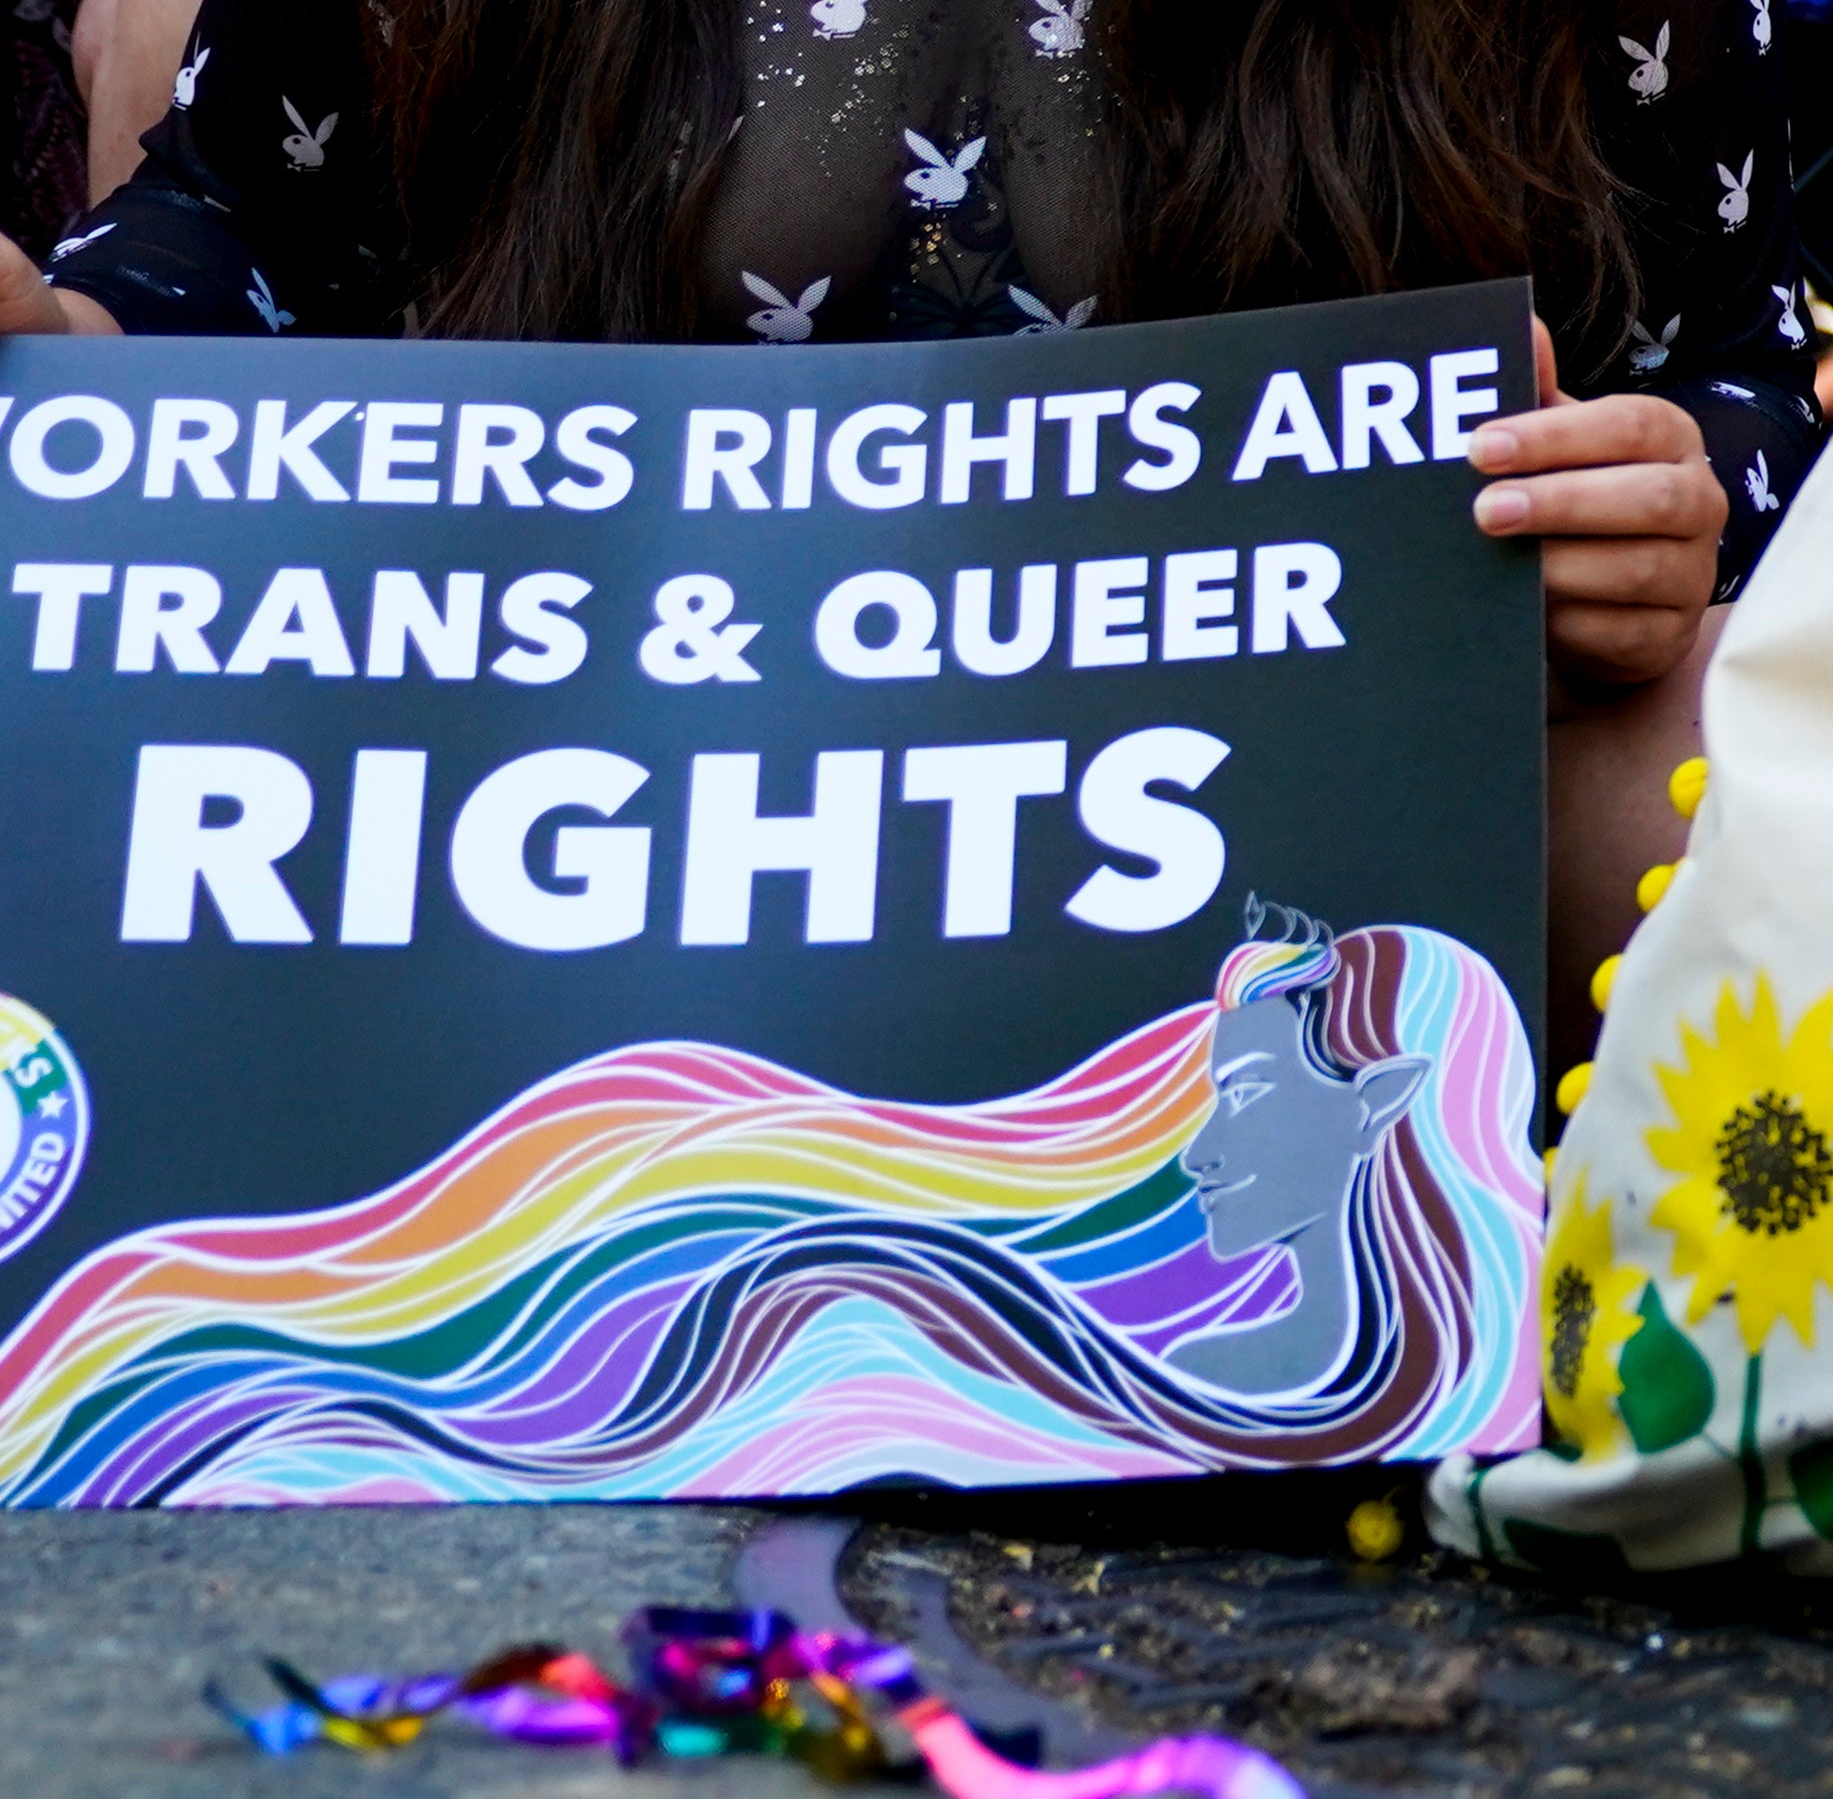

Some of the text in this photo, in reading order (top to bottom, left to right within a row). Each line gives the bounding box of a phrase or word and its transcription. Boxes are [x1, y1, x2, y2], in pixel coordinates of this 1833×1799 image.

[0, 347, 1500, 511] ORKERS RIGHTS ARE
[12, 542, 1347, 685] TRANS & QUEER
[120, 726, 1232, 953] RIGHTS
